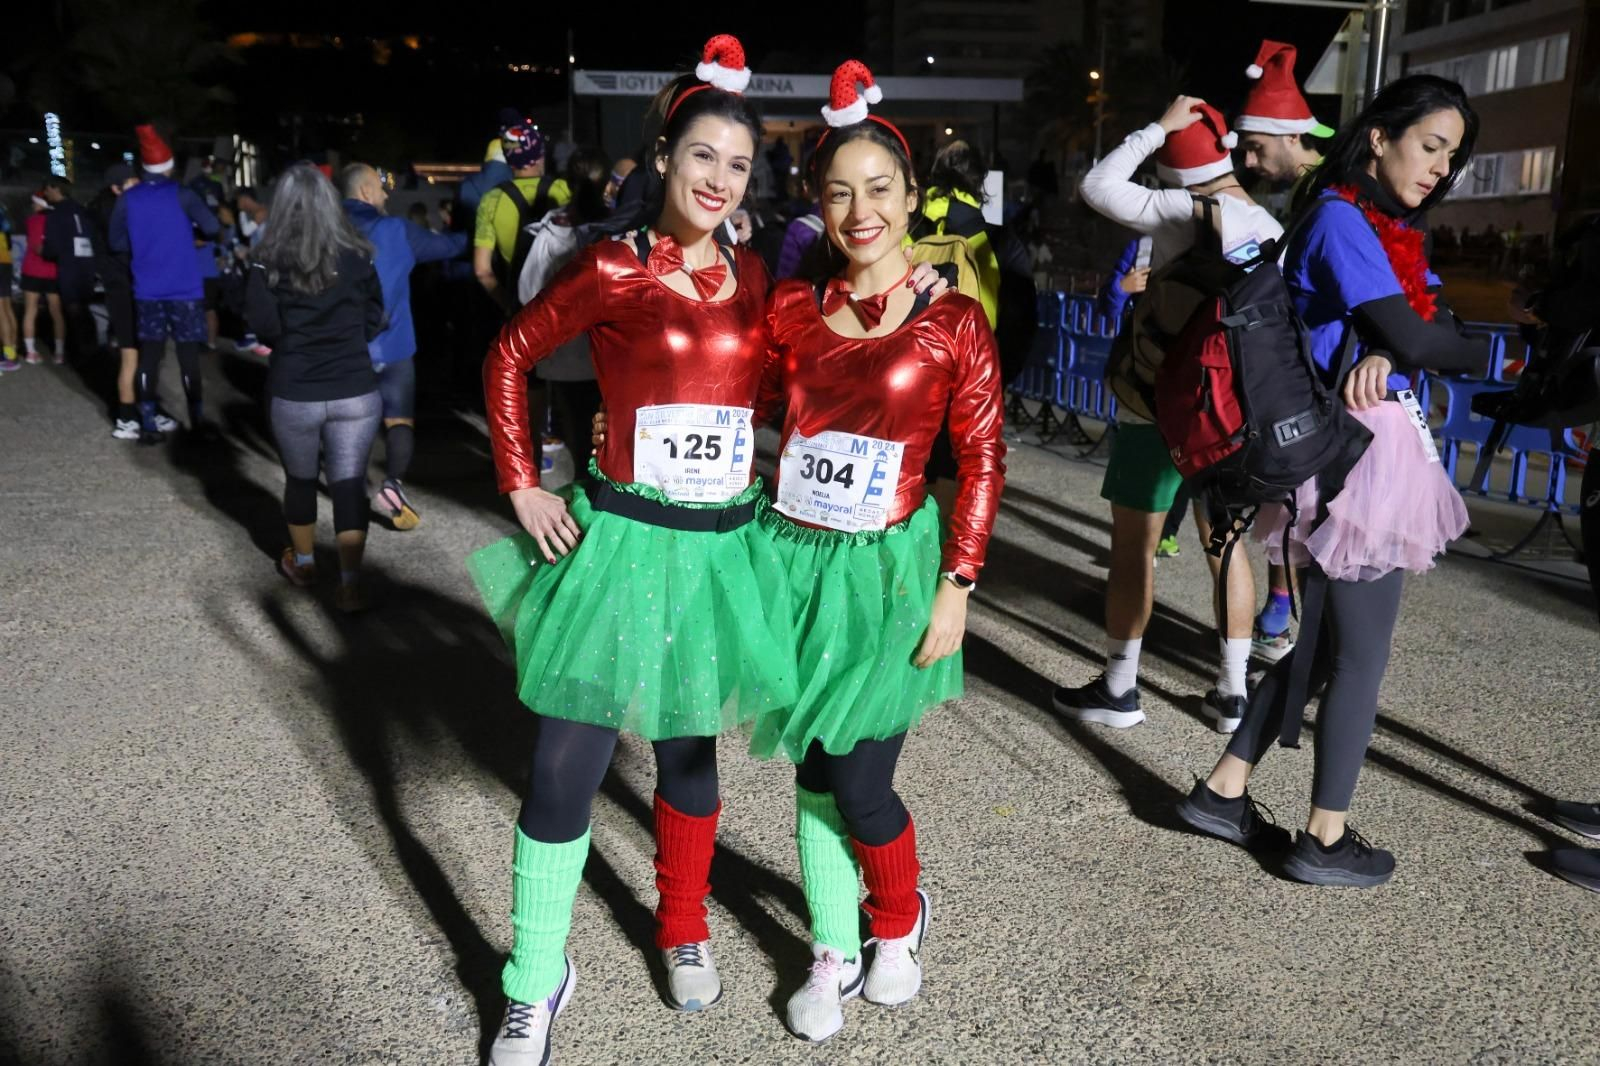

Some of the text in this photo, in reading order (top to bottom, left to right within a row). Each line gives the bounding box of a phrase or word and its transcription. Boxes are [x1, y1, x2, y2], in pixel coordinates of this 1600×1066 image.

[749, 77, 794, 93] ARINA
[716, 409, 731, 426] M
[663, 433, 722, 461] 125
[850, 437, 869, 456] M
[872, 439, 896, 451] 2024
[799, 453, 855, 489] 304
[685, 475, 724, 487] mayoral
[813, 498, 853, 515] mayoral
